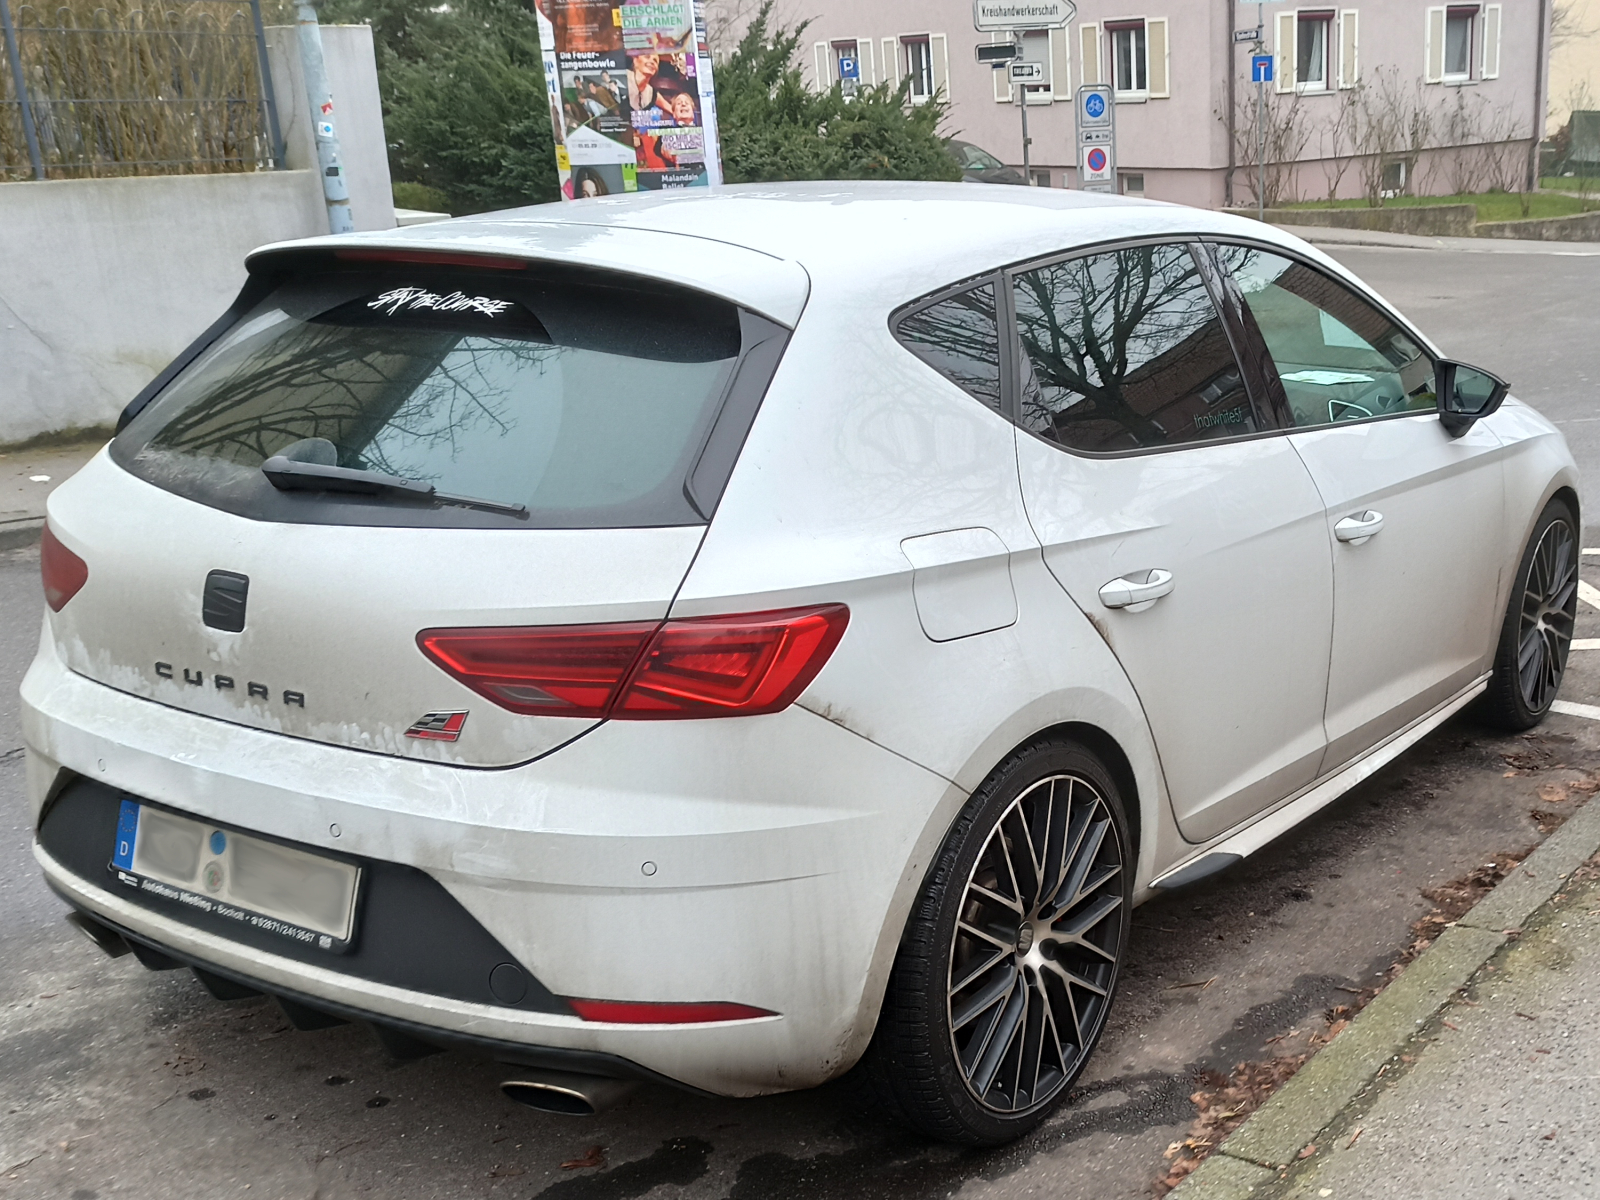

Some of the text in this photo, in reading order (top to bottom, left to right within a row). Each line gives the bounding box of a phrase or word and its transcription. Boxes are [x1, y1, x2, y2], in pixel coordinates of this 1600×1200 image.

[621, 4, 684, 16] ERSCHLAGT
[981, 4, 1059, 18] Kreishandwerkerschaft
[623, 16, 683, 28] DIE ARMEN
[560, 59, 616, 70] zangenbowle
[843, 60, 854, 71] P
[661, 173, 699, 182] Malandain
[432, 291, 515, 318] COURSE
[154, 661, 305, 709] CUPRA
[120, 841, 129, 856] D
